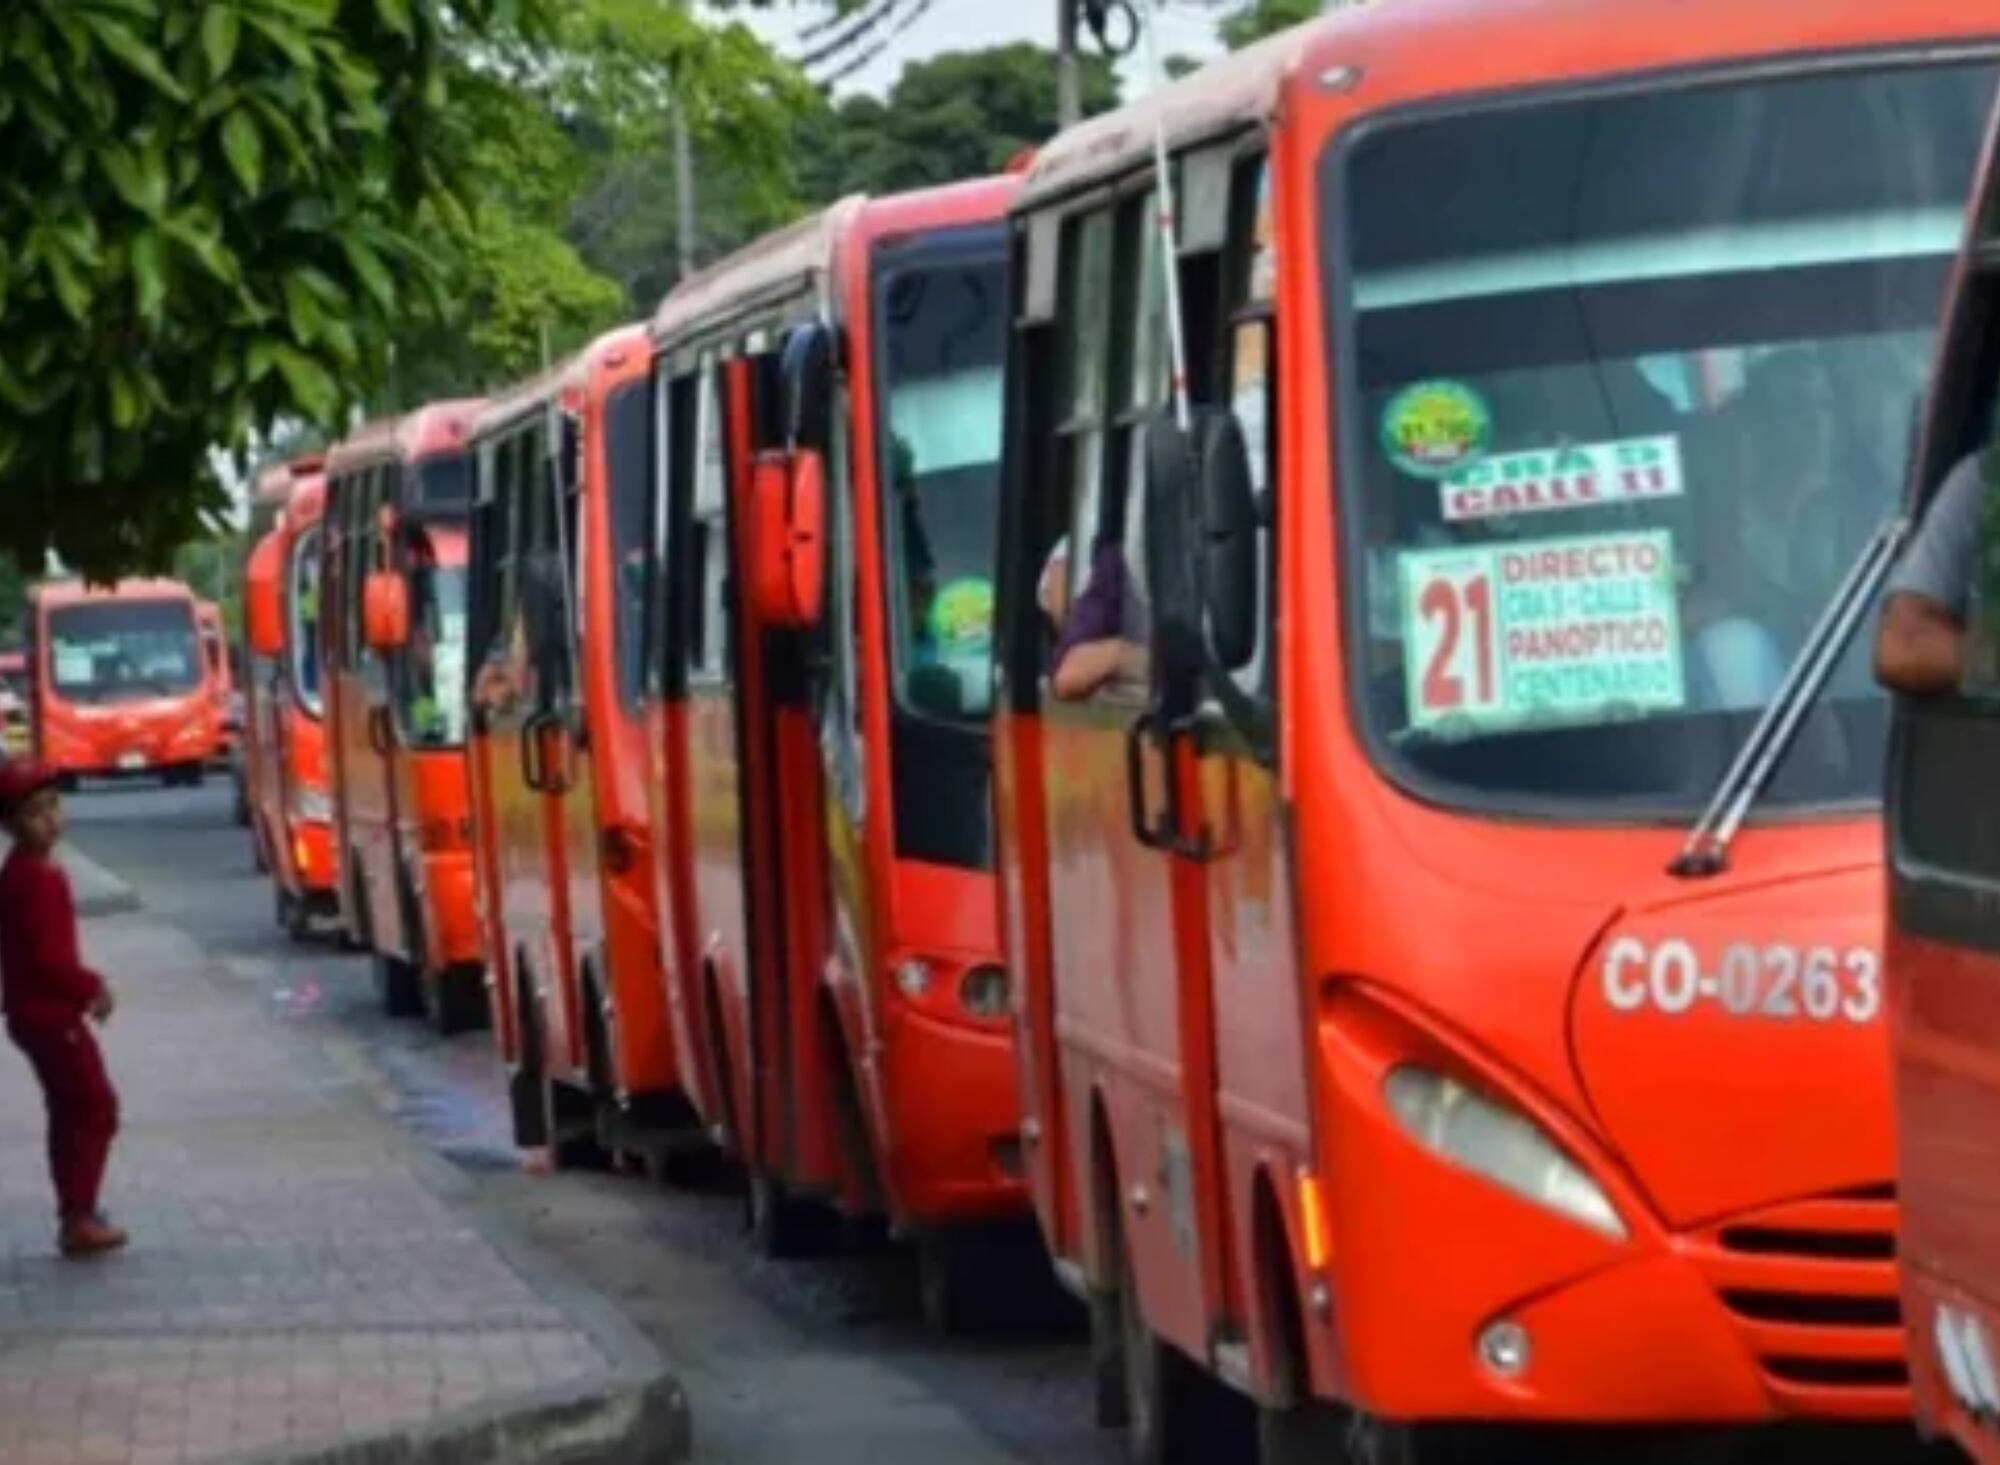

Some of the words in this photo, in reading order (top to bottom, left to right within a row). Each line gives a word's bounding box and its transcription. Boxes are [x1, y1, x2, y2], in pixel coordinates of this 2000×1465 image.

[1453, 473, 1598, 512] CALLE
[1503, 542, 1661, 584] DIRECTO
[1418, 574, 1492, 708] 21
[1508, 618, 1666, 662] PANOPTICO
[1604, 936, 1881, 1022] CO-0263
